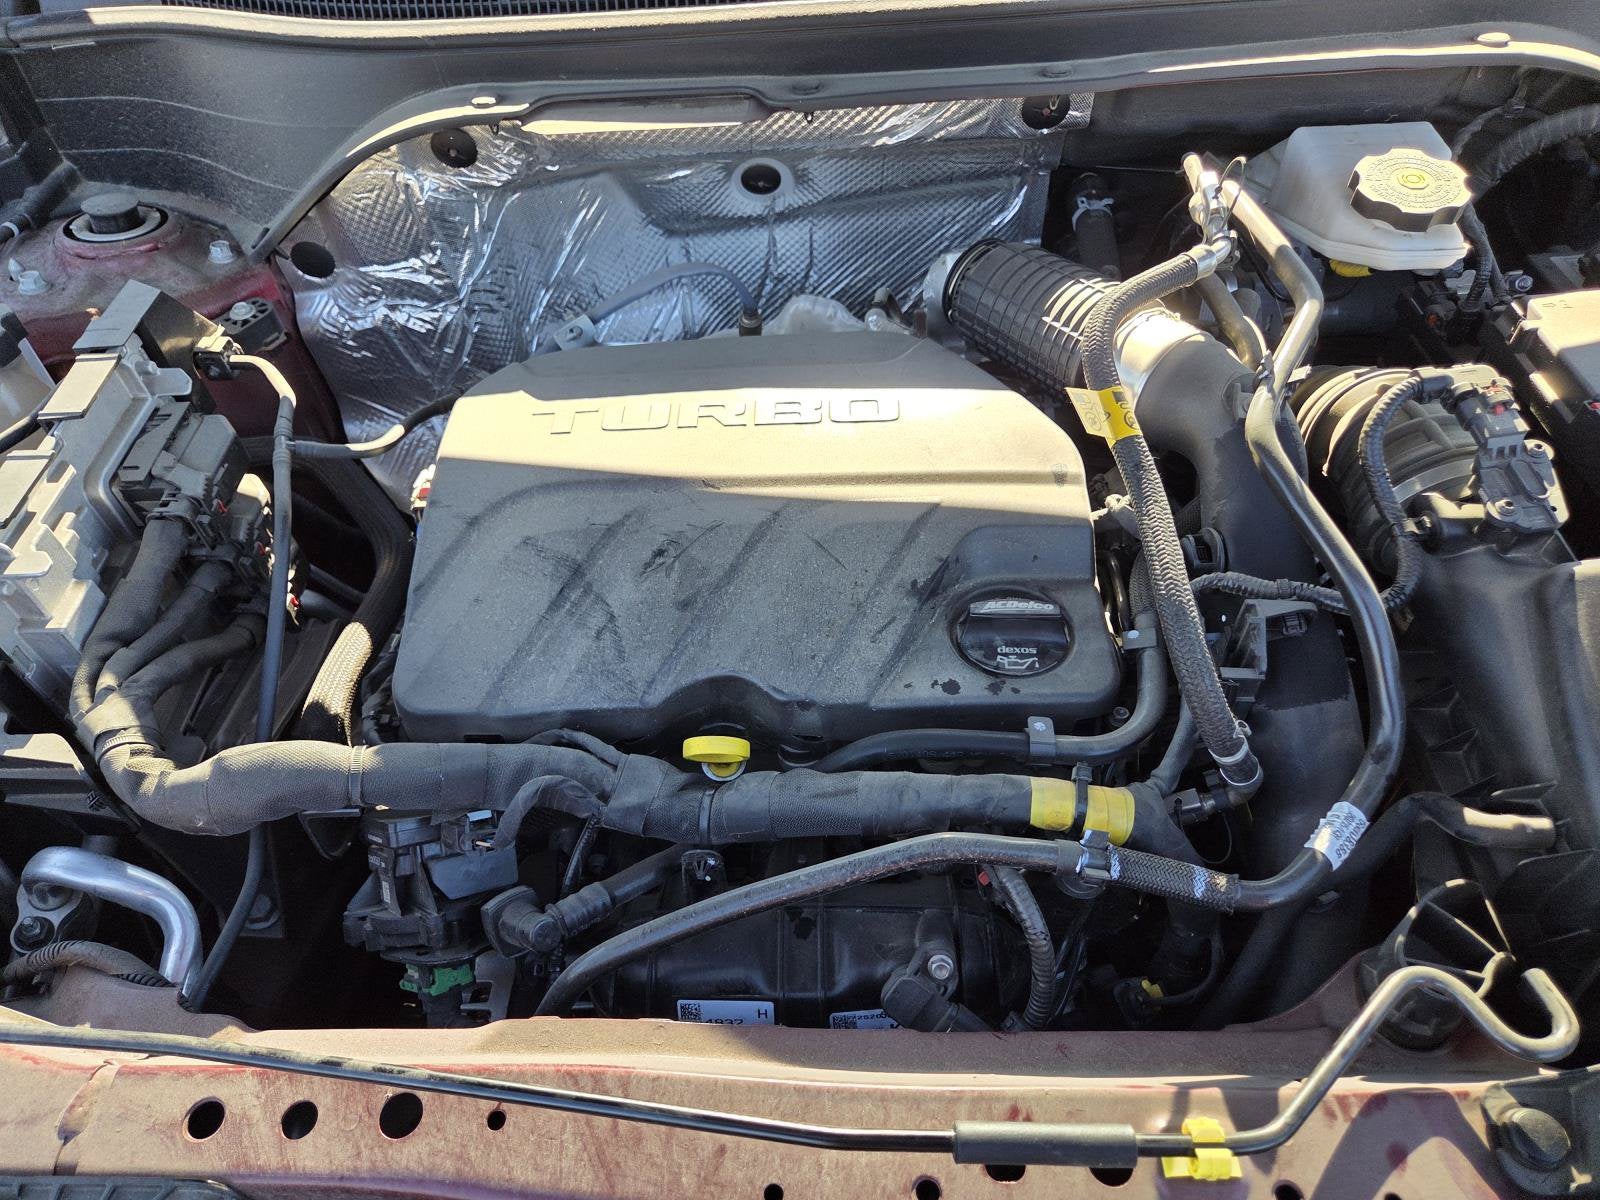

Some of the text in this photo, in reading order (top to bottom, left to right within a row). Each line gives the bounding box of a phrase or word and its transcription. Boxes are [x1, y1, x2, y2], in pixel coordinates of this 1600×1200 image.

[532, 399, 901, 435] TURBO
[982, 600, 1055, 611] ACDelco
[997, 646, 1038, 655] dexos
[757, 1008, 768, 1019] H
